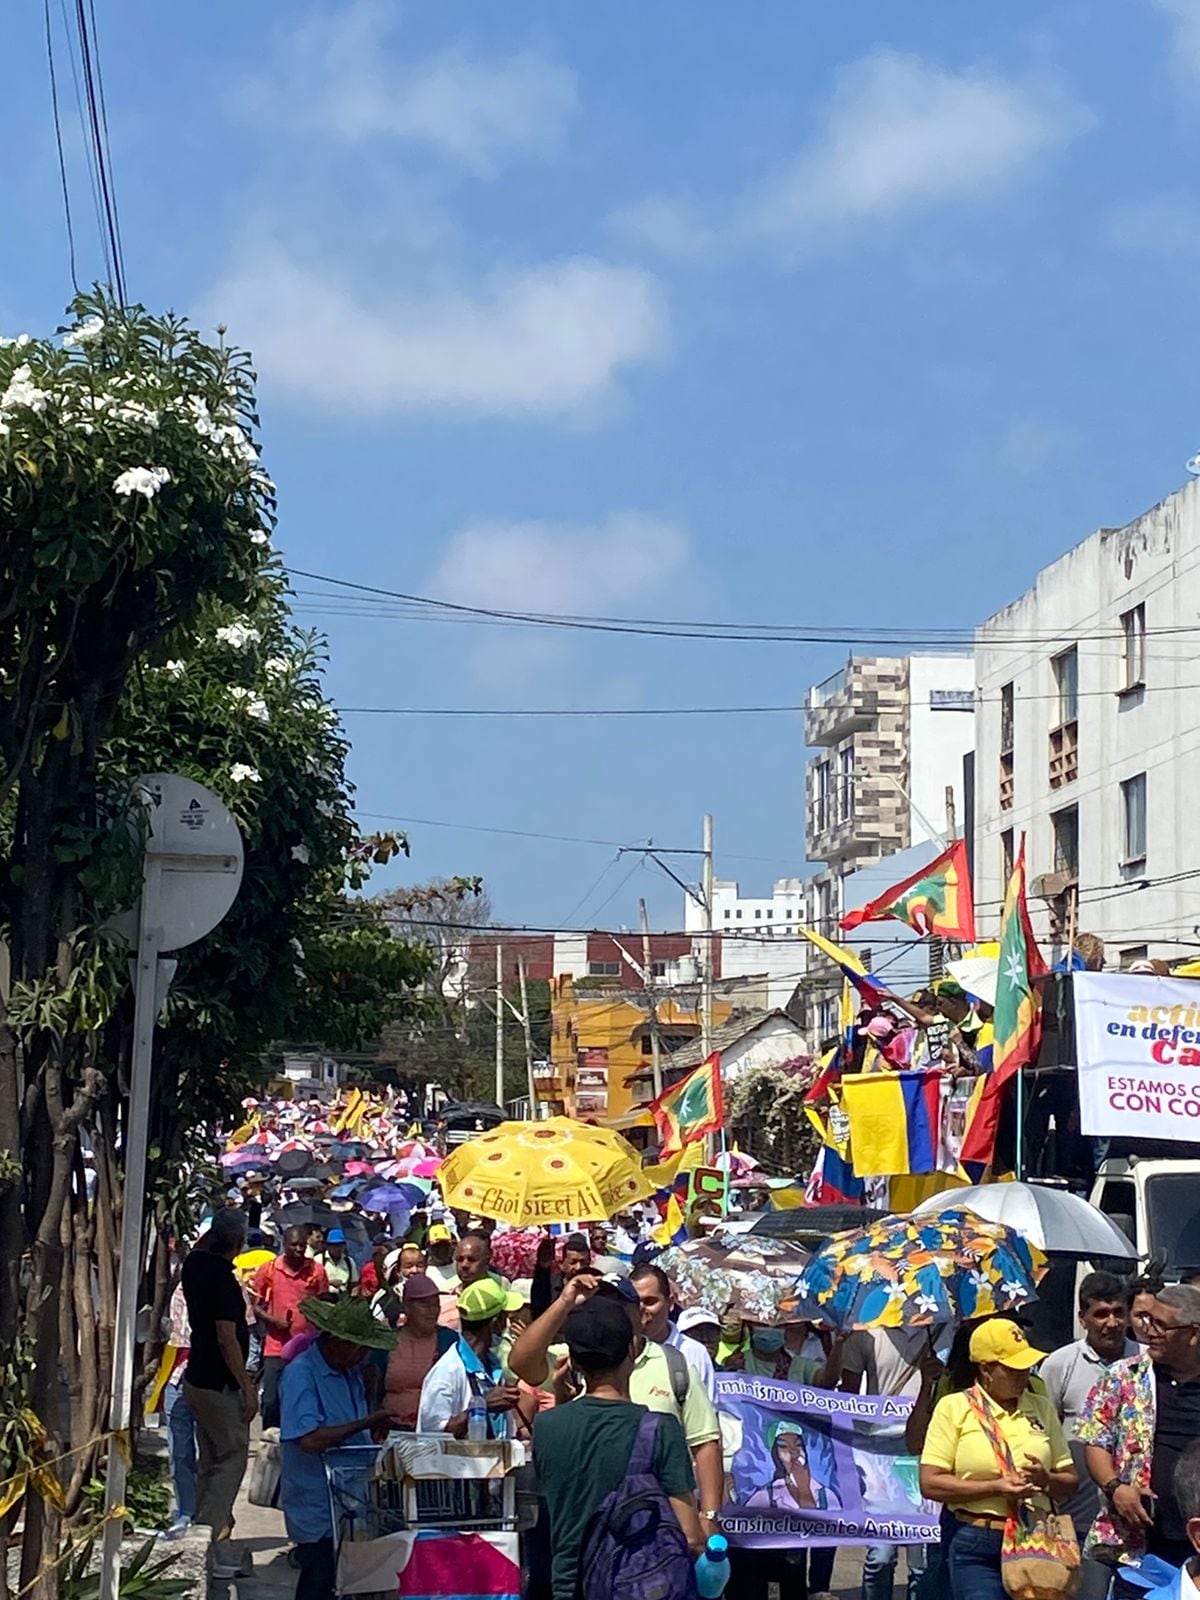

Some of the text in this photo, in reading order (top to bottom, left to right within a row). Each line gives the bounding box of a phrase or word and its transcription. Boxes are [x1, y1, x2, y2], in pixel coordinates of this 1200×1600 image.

[1106, 1022, 1136, 1039] en
[1108, 1076, 1187, 1097] ESTAMOS
[1109, 1092, 1200, 1118] CON CO
[801, 1388, 877, 1415] Popular
